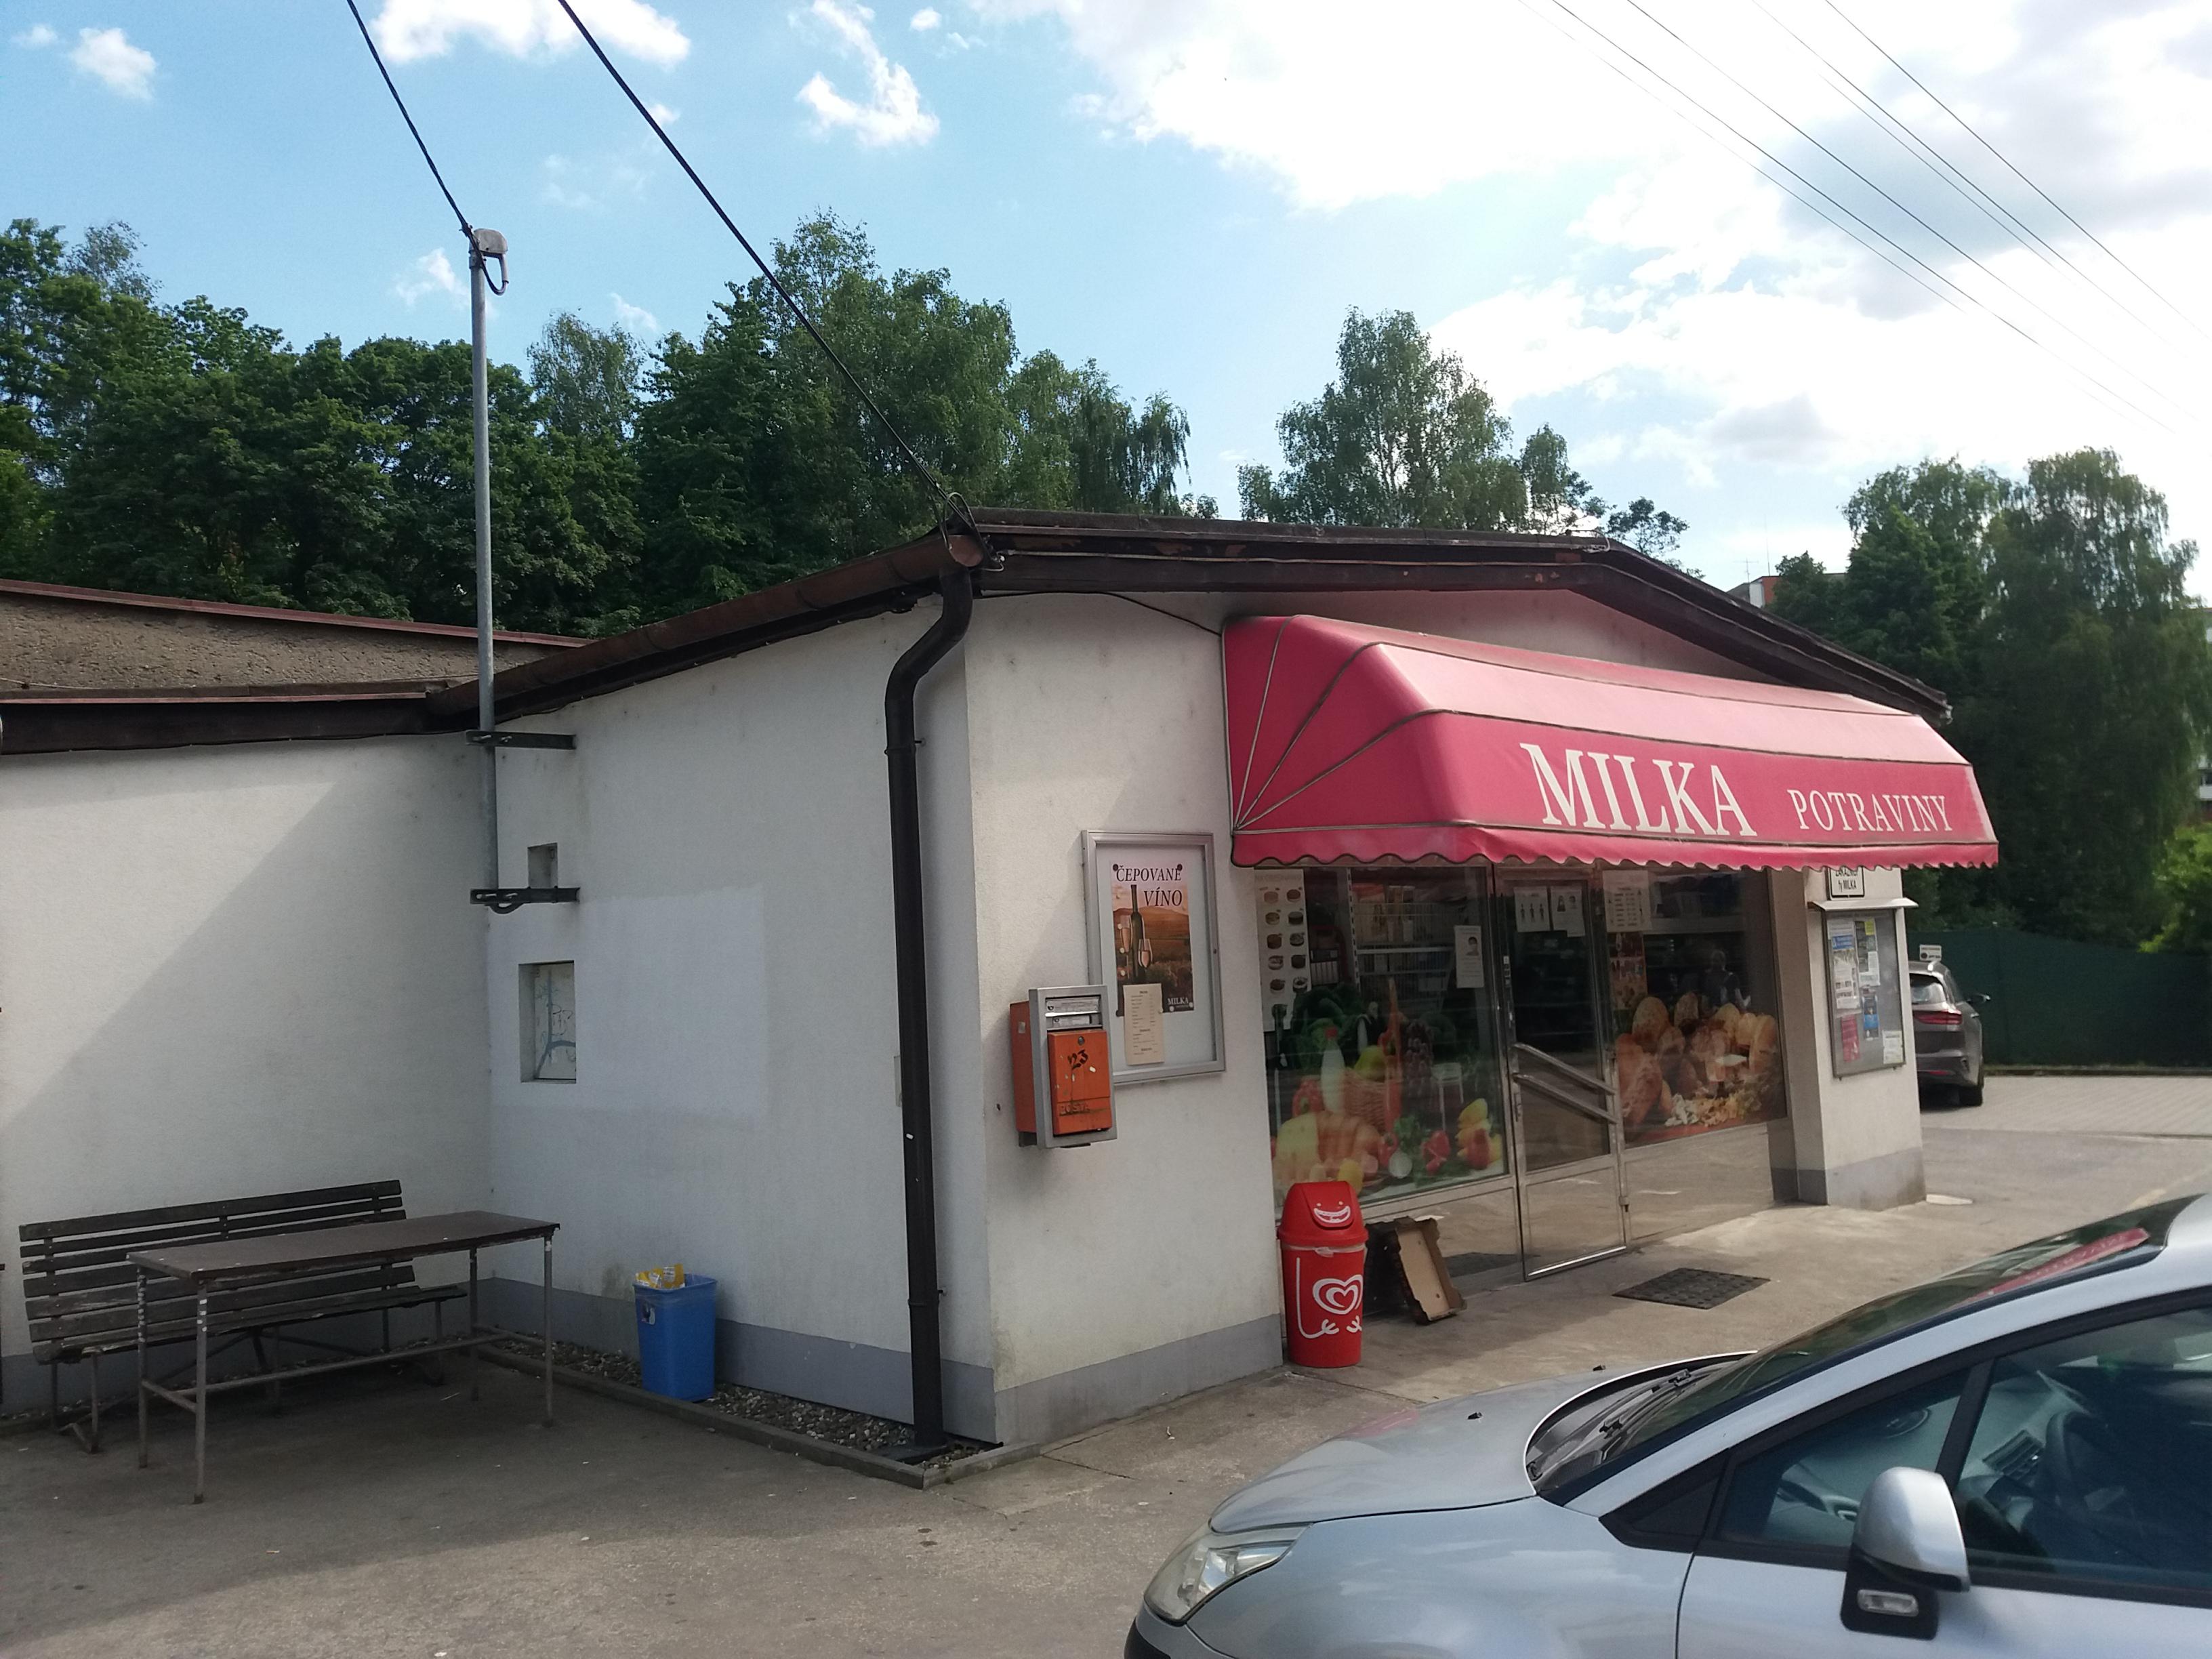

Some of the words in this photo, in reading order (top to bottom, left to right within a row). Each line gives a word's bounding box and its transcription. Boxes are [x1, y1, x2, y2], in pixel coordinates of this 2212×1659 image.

[1519, 743, 1758, 836] MILKA
[1787, 789, 1952, 832] POTRAVINY
[1143, 886, 1183, 907] VÍNO
[1167, 997, 1189, 1006] MILKA
